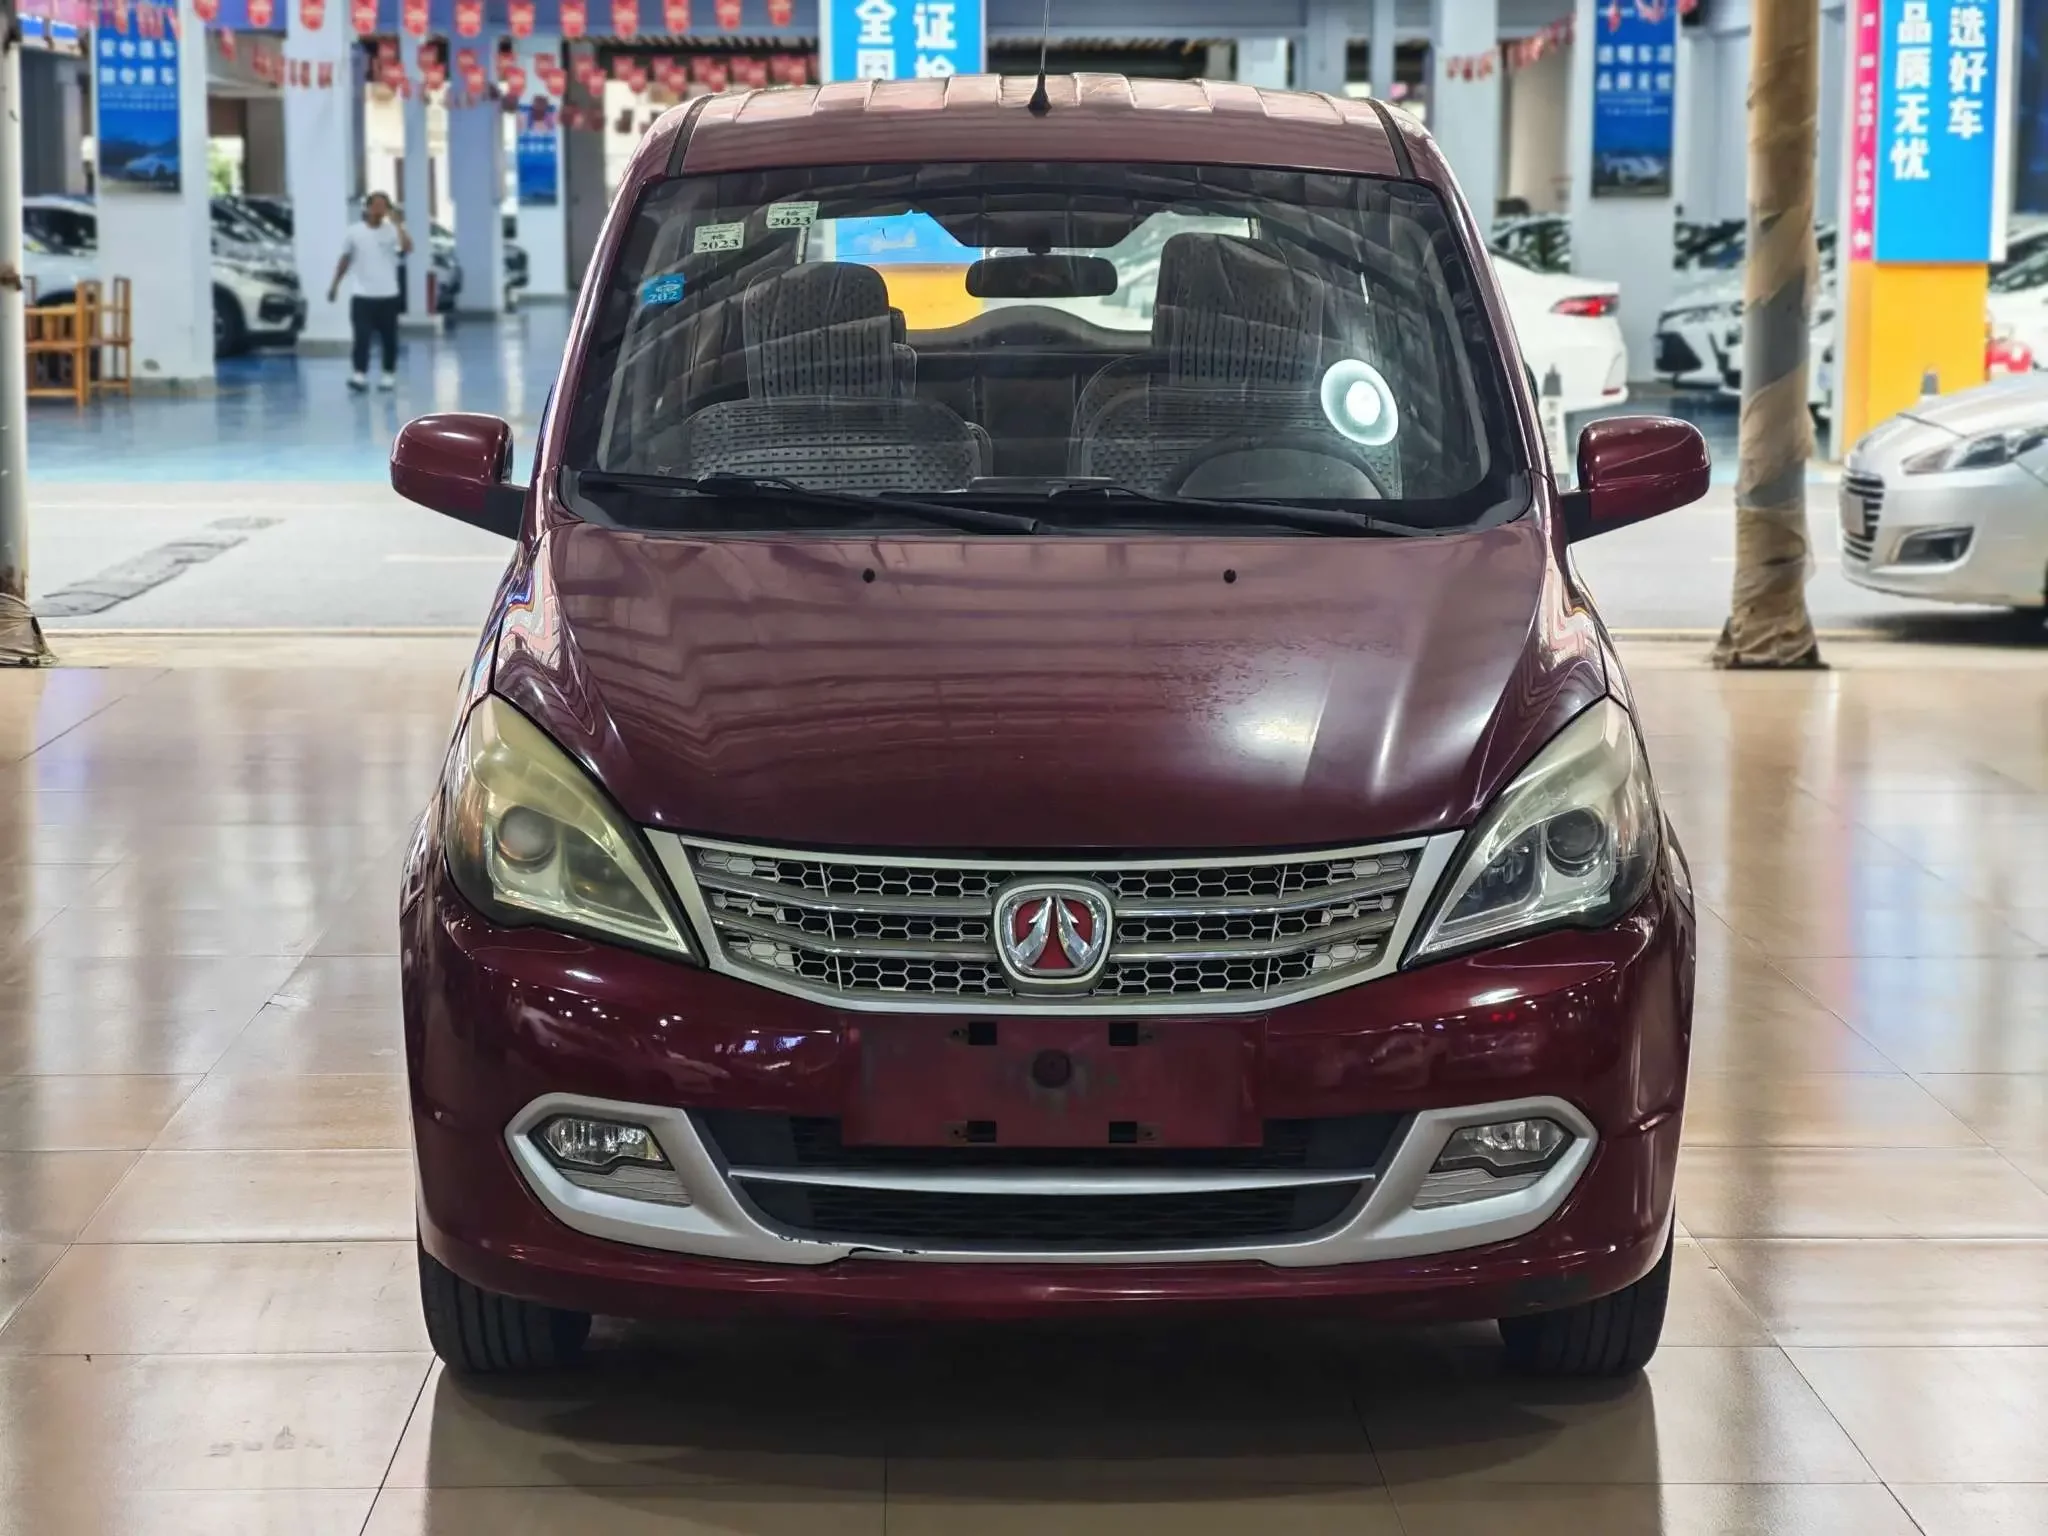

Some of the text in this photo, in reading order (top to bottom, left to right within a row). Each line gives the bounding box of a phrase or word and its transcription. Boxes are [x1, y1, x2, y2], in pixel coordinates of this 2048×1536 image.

[1889, 1, 1932, 180] 品质无忧
[1947, 0, 1988, 139] 选好车
[701, 239, 739, 250] 2023
[771, 216, 811, 226] 2023
